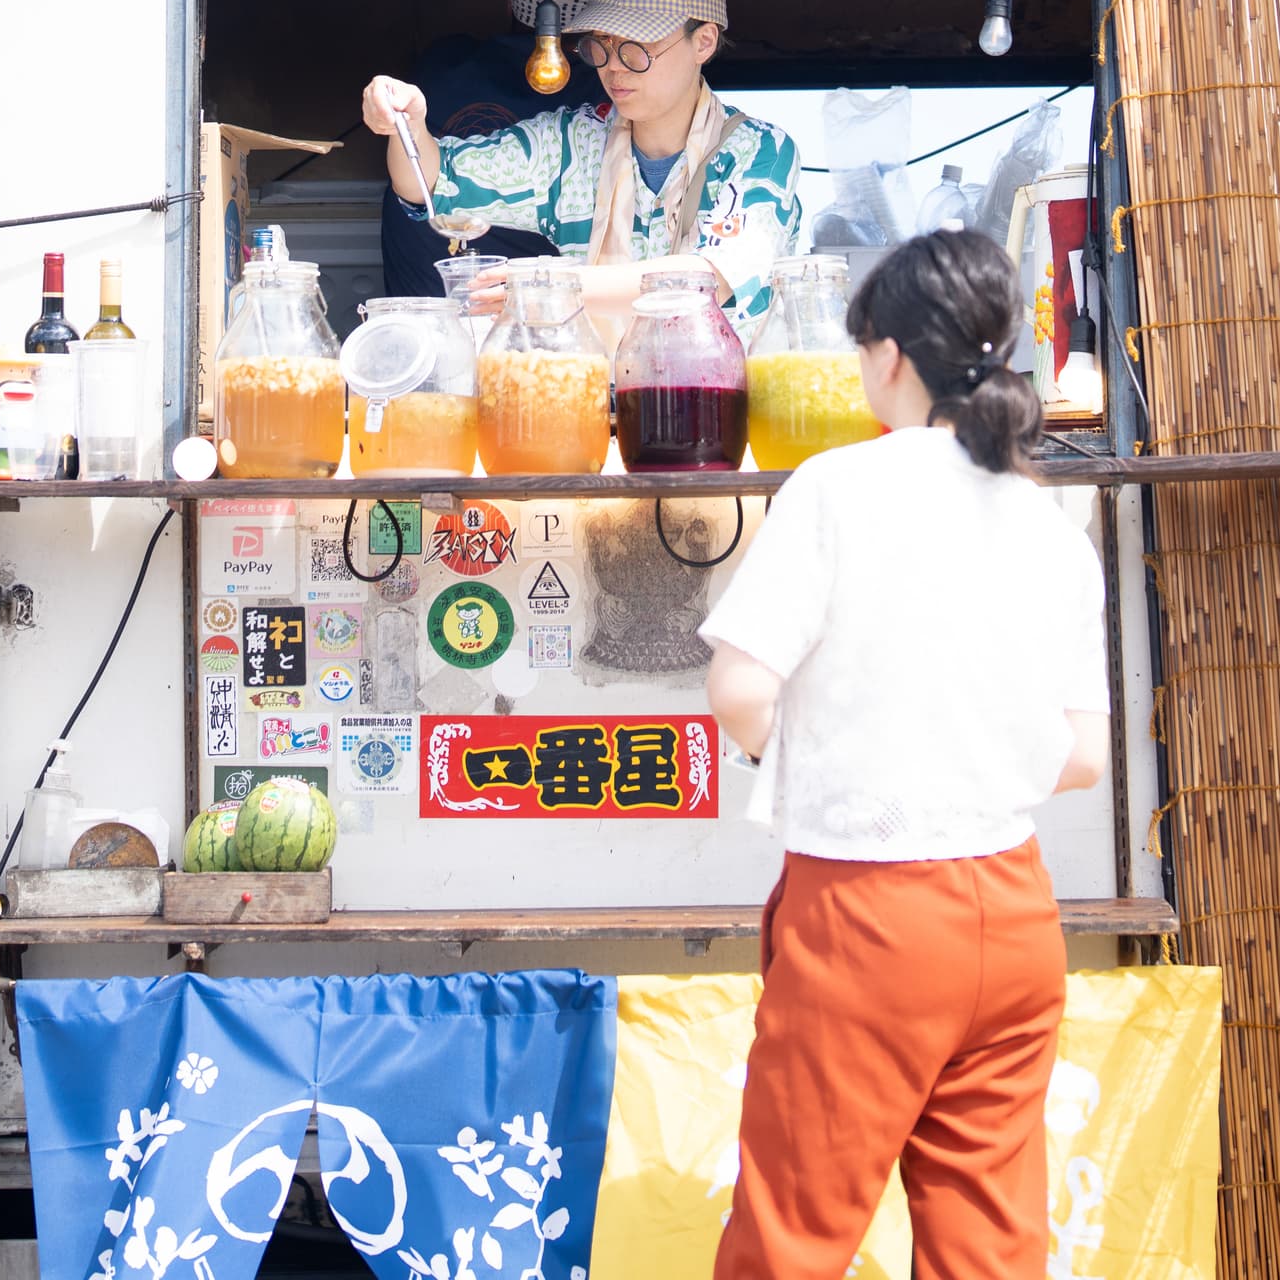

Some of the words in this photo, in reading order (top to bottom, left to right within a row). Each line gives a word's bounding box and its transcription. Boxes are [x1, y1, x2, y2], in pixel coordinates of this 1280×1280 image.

[322, 514, 360, 525] PayPy
[223, 561, 273, 575] PayPay
[245, 610, 268, 685] 和解せよ
[463, 723, 683, 811] 一番星
